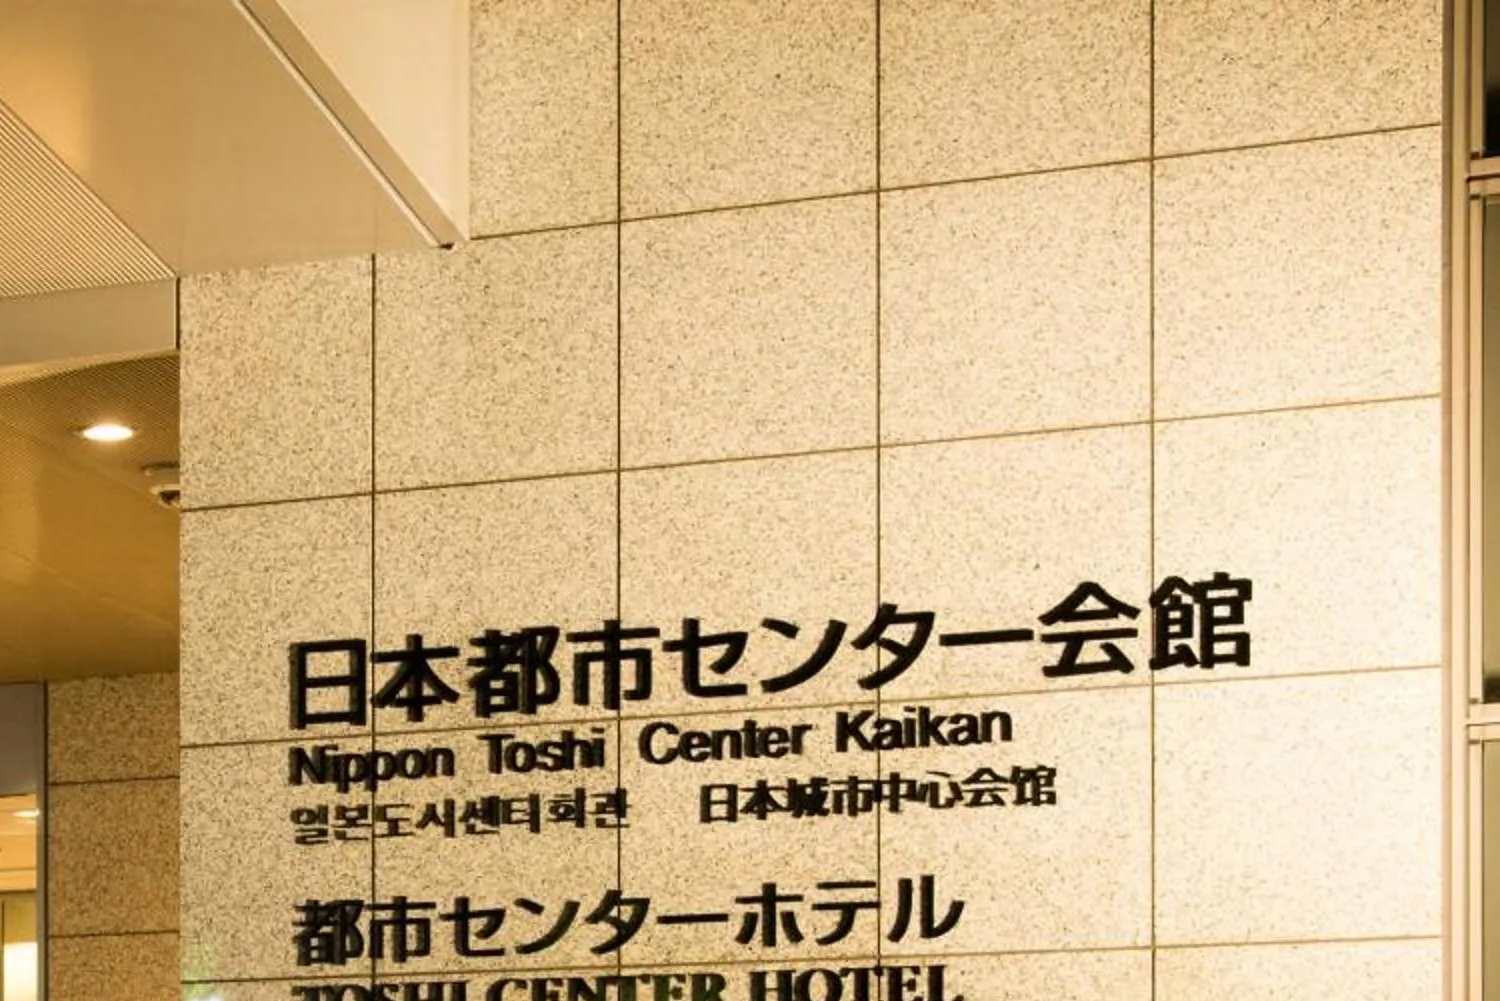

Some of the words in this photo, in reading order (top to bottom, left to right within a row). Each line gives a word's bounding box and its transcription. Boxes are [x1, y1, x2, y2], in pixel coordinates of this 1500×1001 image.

[288, 571, 1252, 730] 日本都市センター会館
[288, 744, 455, 793] Nippon
[477, 727, 606, 774] Toshi
[639, 719, 812, 764] Center
[835, 706, 1013, 752] Kaikan
[290, 788, 632, 844] 일본도시센터회관
[291, 875, 966, 966] 都市センターホテル
